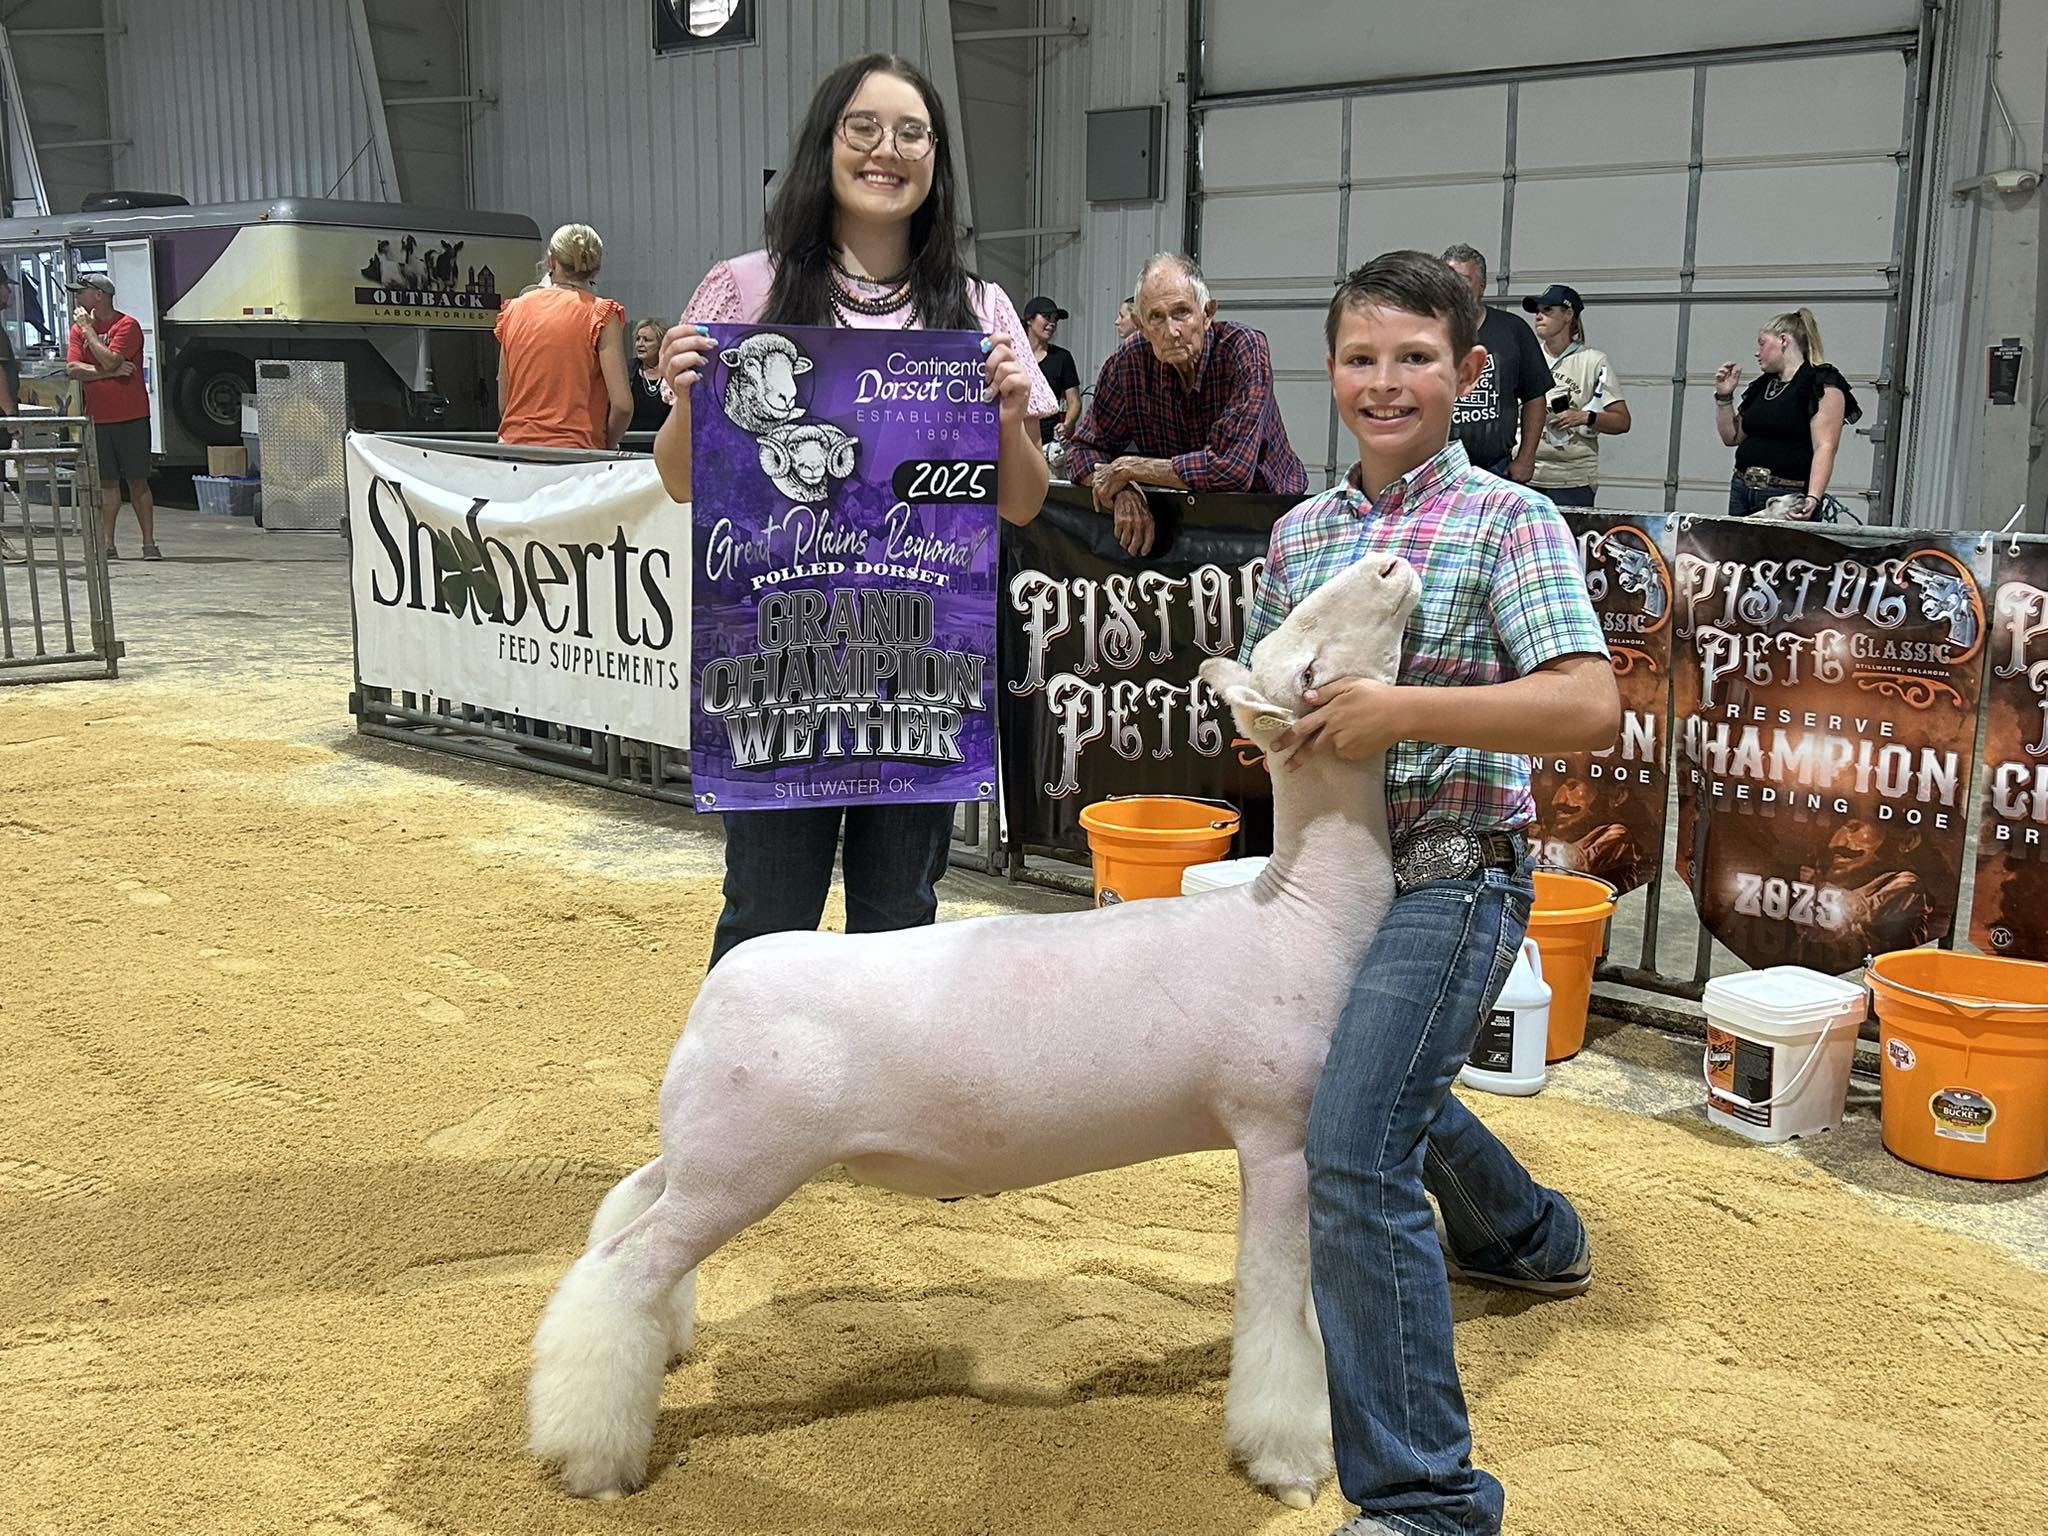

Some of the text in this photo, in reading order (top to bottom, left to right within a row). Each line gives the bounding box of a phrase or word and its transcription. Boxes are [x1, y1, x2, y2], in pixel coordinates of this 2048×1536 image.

[373, 290, 484, 308] OUTBACK
[374, 308, 485, 319] LABORATORIES
[853, 369, 943, 405] Dorset
[857, 409, 995, 424] ESTABLISHED
[1452, 407, 1499, 424] CROSS.
[915, 429, 960, 441] 1898
[908, 462, 995, 499] 2025
[705, 503, 988, 581] Great Plains Regional
[368, 475, 674, 650] Shberts
[750, 561, 950, 590] POLLED DORSET
[1675, 552, 1908, 639] PISTOL
[757, 588, 935, 650] GRAND
[1602, 611, 1647, 633] SSIC
[499, 633, 679, 690] FEED SUPPLEMENTS
[1696, 624, 1952, 710] PETE CLASSIC
[1906, 667, 1950, 677] OKLAHOMA
[700, 645, 987, 716] CHAMPION
[724, 701, 965, 769] WETHER
[1044, 672, 1225, 799] PETE
[1726, 704, 1893, 737] RESERVE
[1590, 764, 1650, 783] DOE
[1684, 714, 1959, 807] CHAMPION
[775, 777, 917, 798] STILLWATER, OK
[1878, 805, 1949, 829] DOE
[1943, 1107, 1980, 1120] BUCKET
